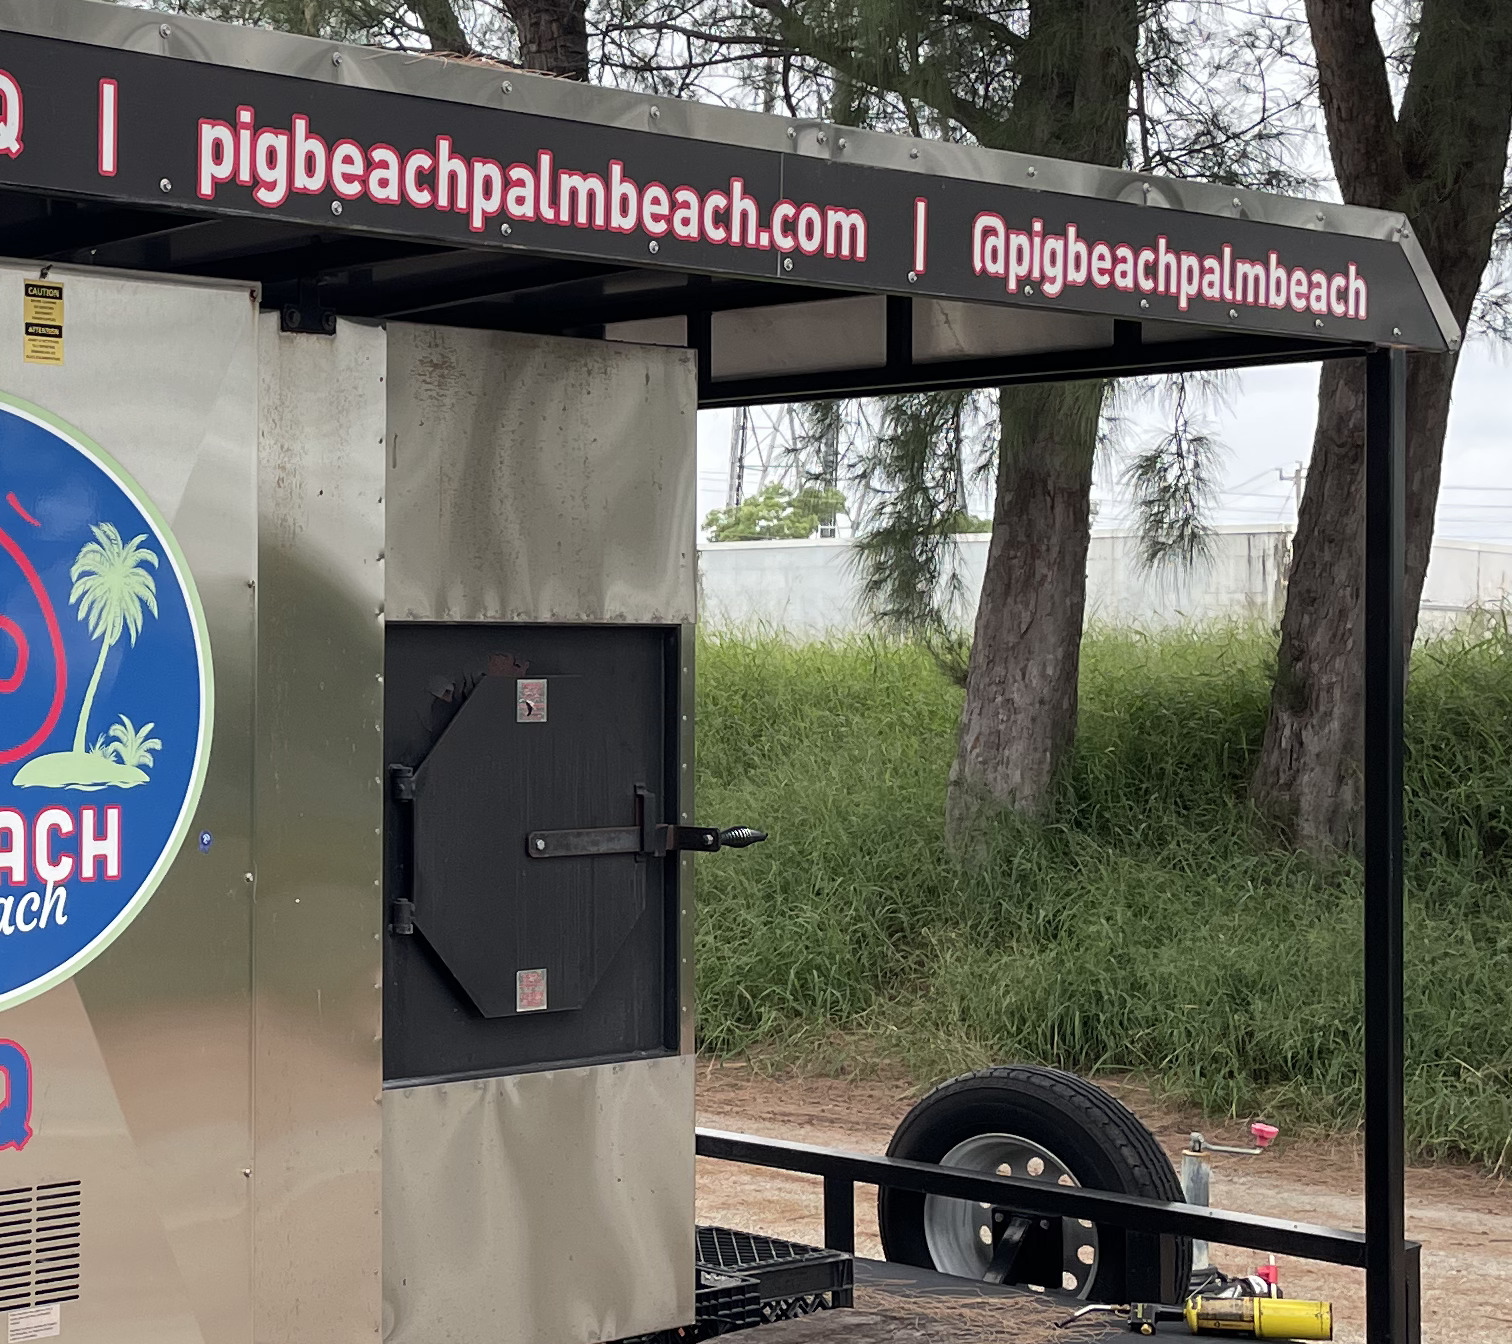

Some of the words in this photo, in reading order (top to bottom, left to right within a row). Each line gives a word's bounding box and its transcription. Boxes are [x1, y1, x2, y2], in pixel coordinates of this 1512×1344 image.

[197, 105, 867, 262] pigbeachpalmbeach.com
[971, 210, 1368, 320] @pigbeachpalmbeach
[28, 286, 59, 297] CAUTION
